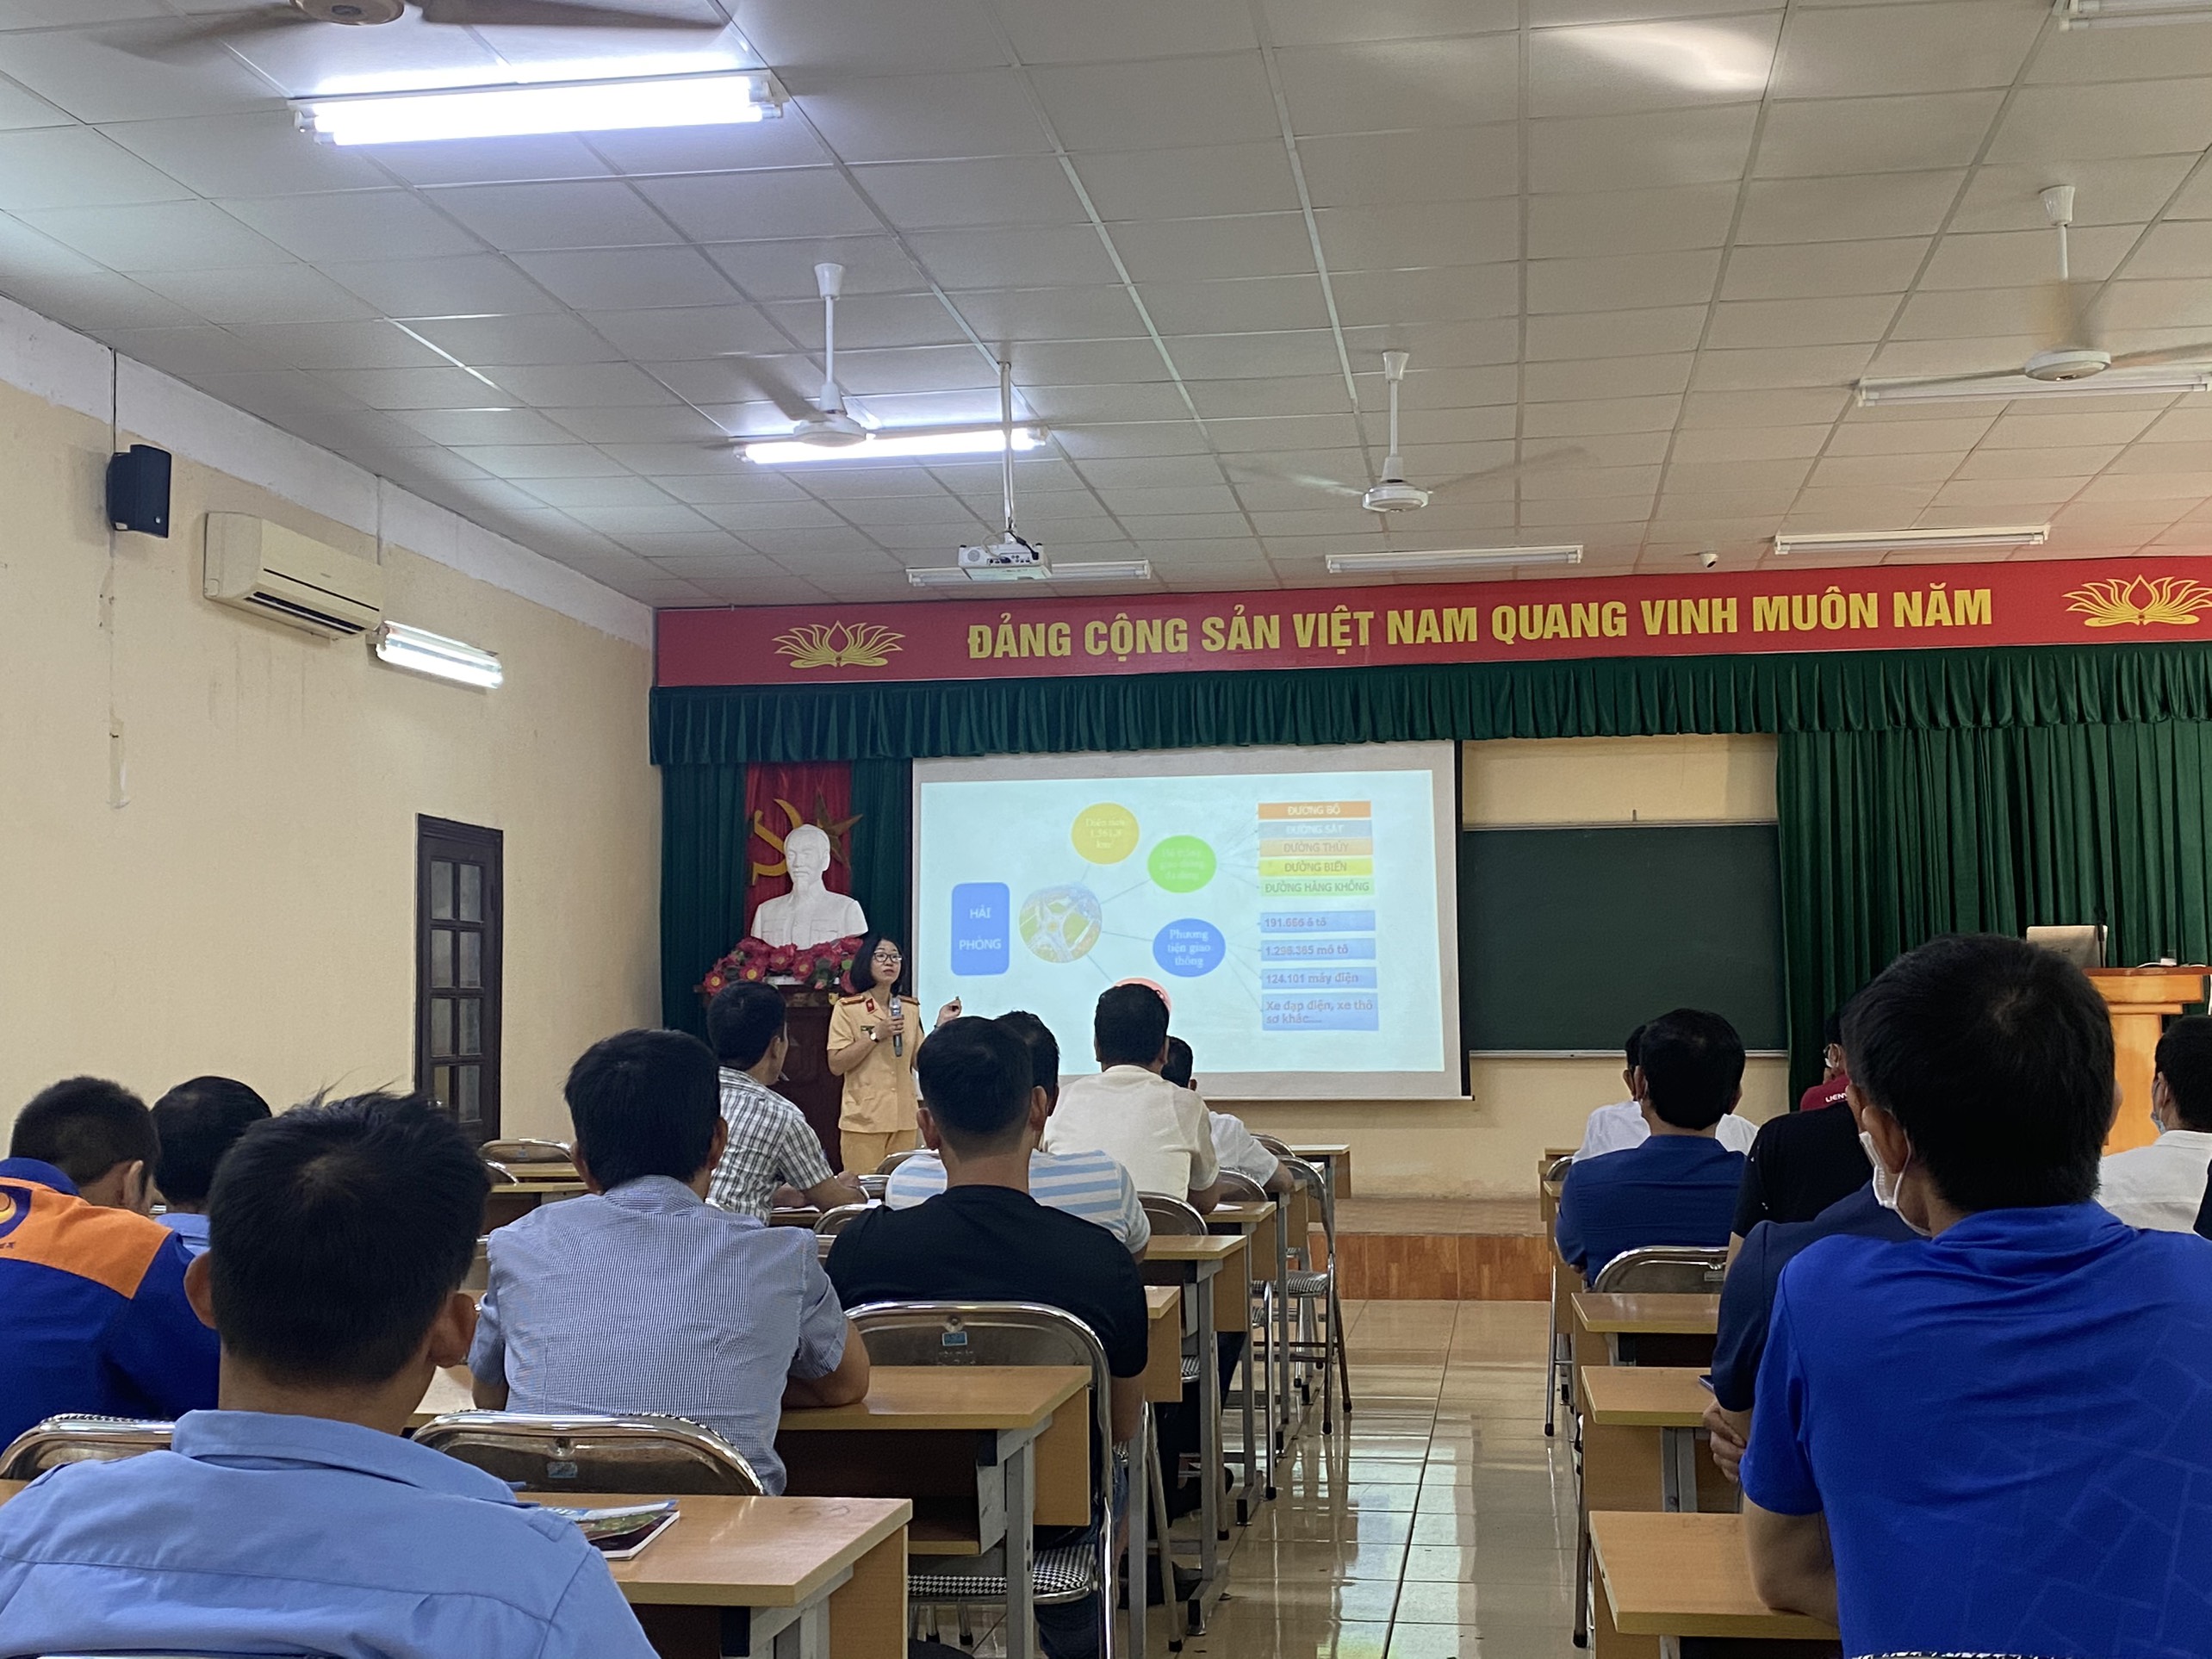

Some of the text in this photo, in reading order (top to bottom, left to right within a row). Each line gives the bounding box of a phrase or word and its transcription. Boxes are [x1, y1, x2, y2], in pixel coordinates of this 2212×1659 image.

[968, 582, 1992, 662] ĐẢNG CỘNG SẢN VIỆT NAM QUANG VINH MUÔN NĂM
[1283, 842, 1320, 853] ĐƯỜNG
[1284, 861, 1321, 872] ĐƯỜNG
[1264, 879, 1370, 892] ĐƯỜNG HÀNG KHÔNG
[970, 904, 991, 919] HẢI
[959, 935, 1002, 951] PHÒNG
[1337, 944, 1349, 954] tô
[1266, 1001, 1281, 1010] Xe
[1337, 1002, 1351, 1010] xe
